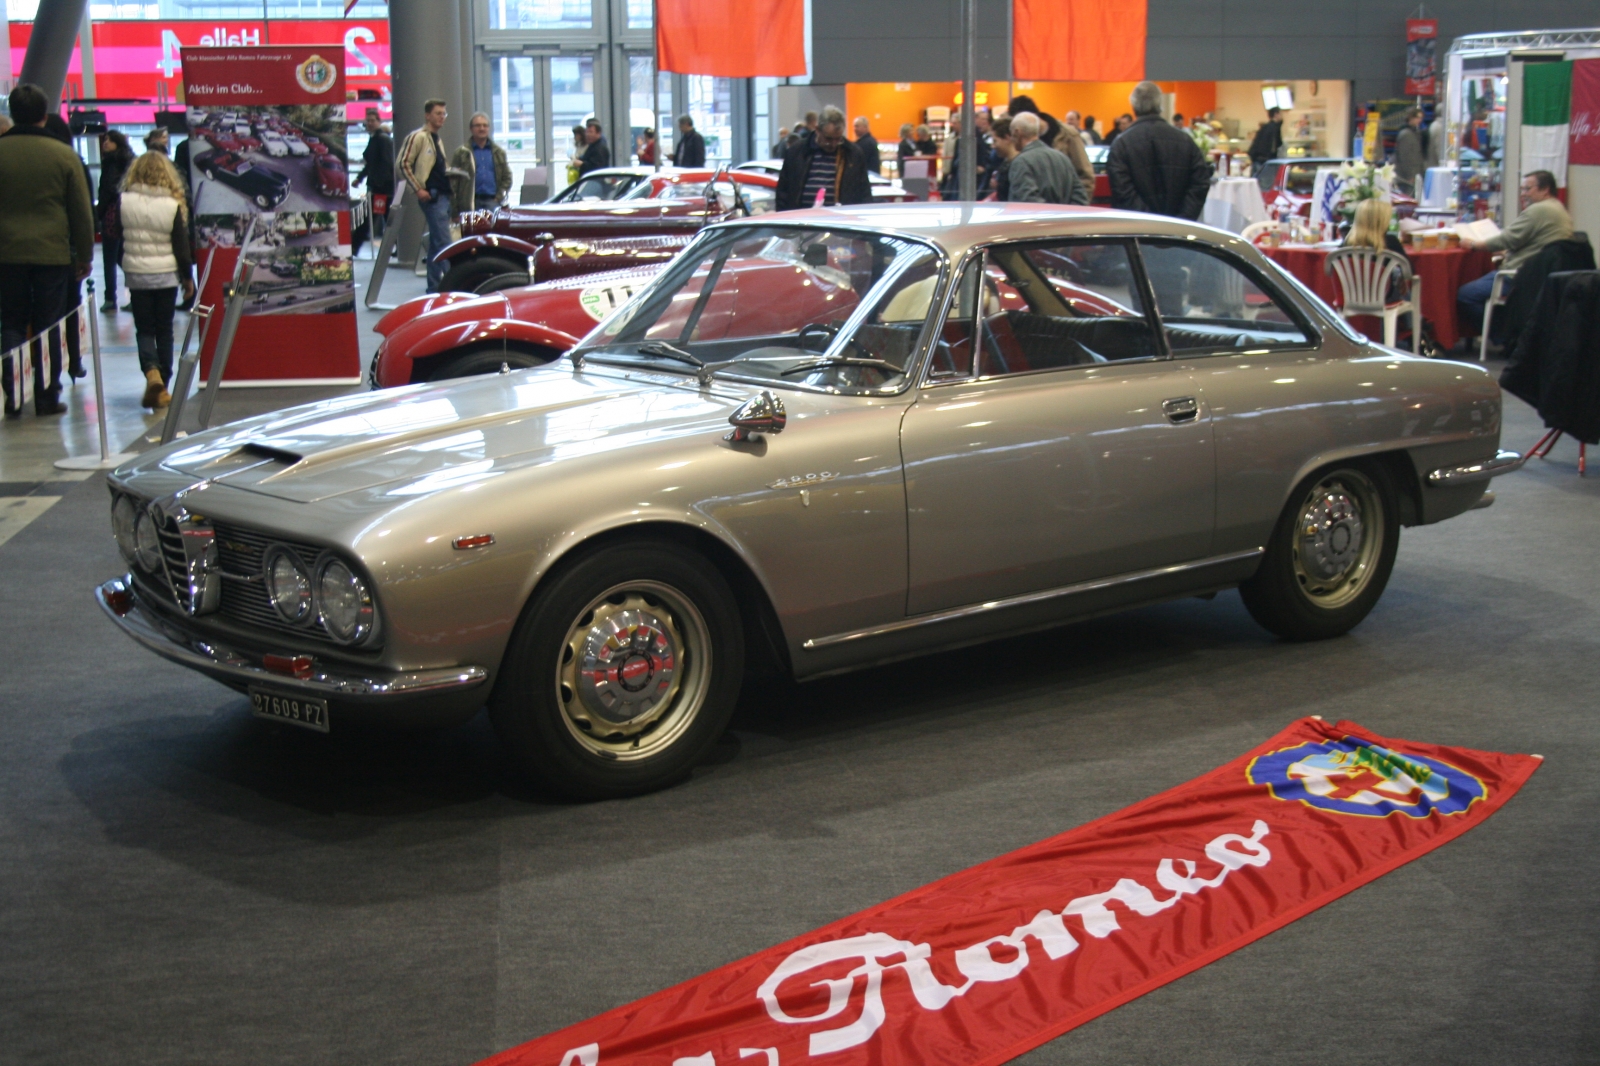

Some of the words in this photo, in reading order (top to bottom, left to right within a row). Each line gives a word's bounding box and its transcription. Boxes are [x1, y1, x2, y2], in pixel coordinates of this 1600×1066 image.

[186, 54, 198, 62] Club
[257, 54, 282, 62] Fahrzeuge
[188, 84, 214, 95] Aktiv
[216, 84, 229, 94] im
[231, 83, 263, 94] Club...
[255, 694, 299, 718] 27609
[305, 704, 322, 725] PZ
[756, 819, 1271, 1056] Romeo
